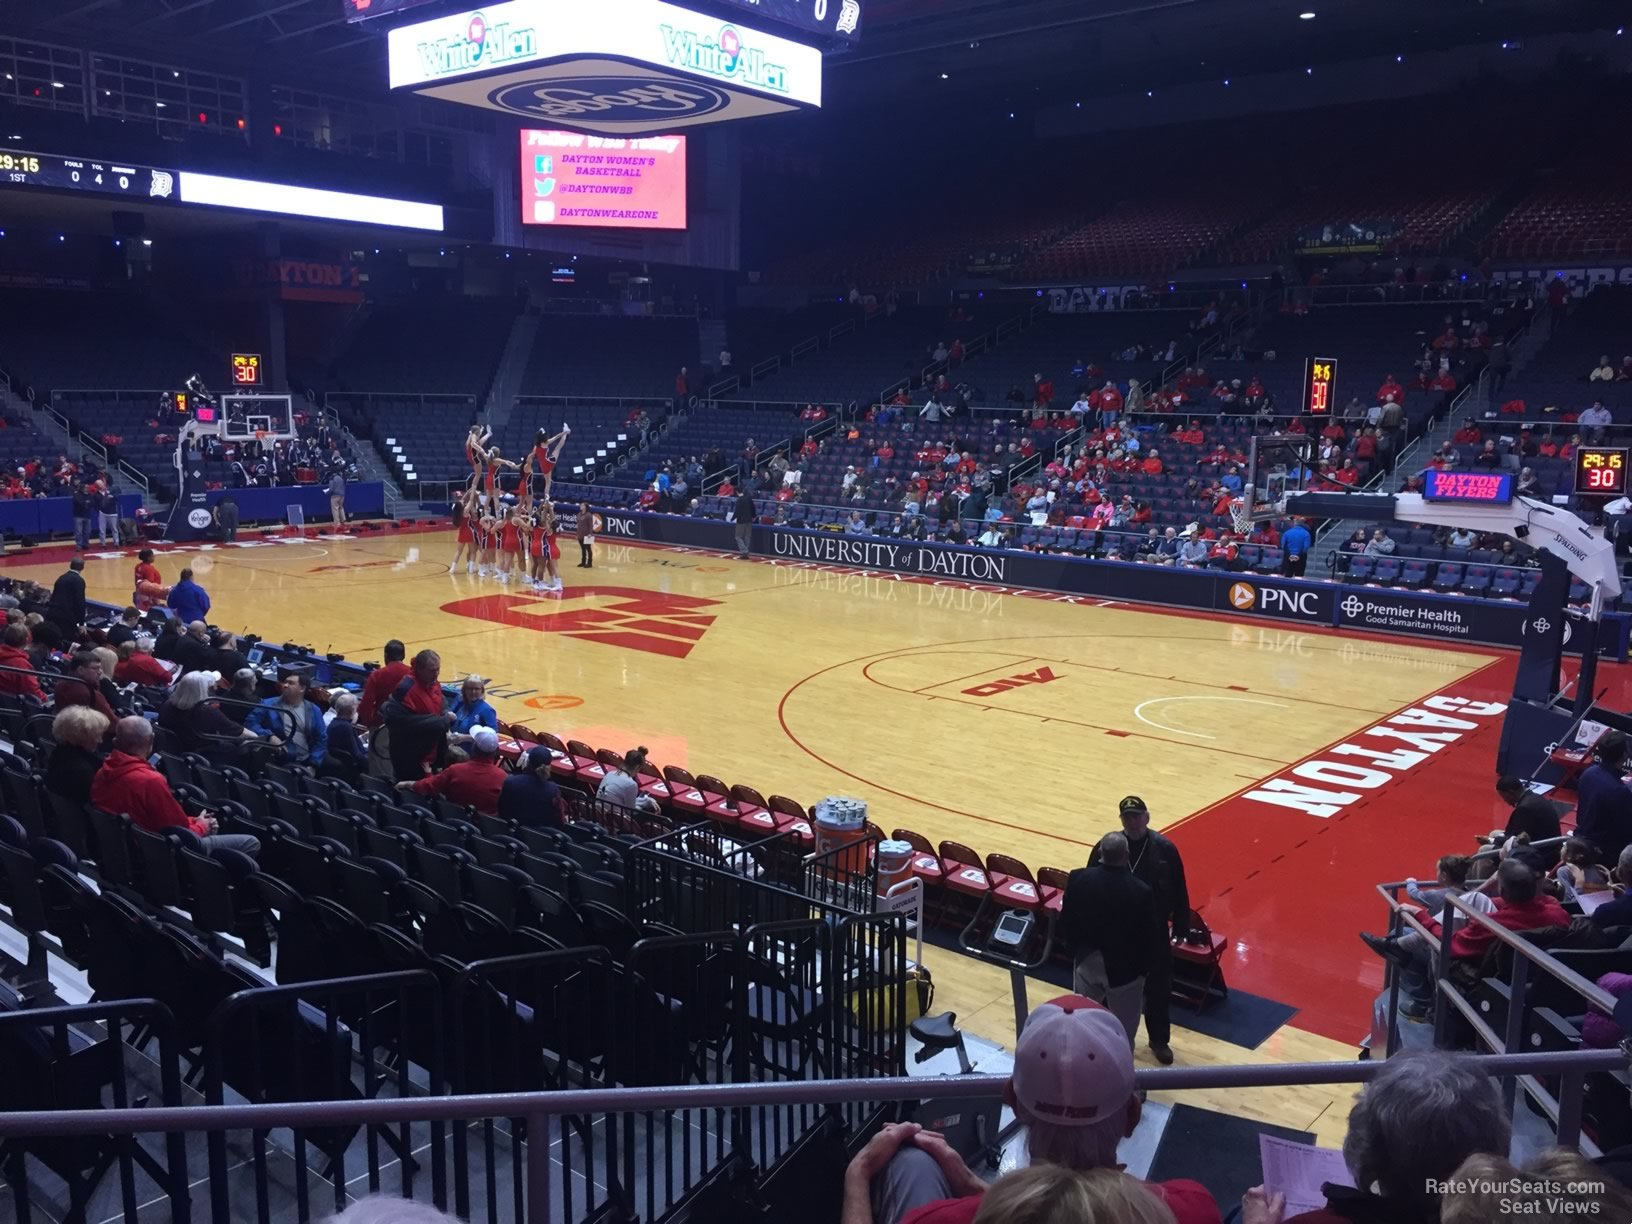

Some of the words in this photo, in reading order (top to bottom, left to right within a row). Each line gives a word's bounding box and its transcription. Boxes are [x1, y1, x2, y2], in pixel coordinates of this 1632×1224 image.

[64, 160, 83, 168] FOULS
[91, 163, 104, 171] TOL
[562, 154, 604, 164] DAYTON
[606, 155, 655, 166] WOMEN'S
[9, 173, 26, 182] 1ST
[575, 166, 642, 177] BASKETBALL
[71, 171, 80, 182] 0
[95, 174, 103, 185] 4
[119, 176, 129, 189] 0
[559, 184, 634, 195] @DAYTONWBB
[559, 207, 659, 219] DAYTONWEAREONE
[237, 366, 256, 382] 30
[1583, 453, 1622, 469] 29:15
[1434, 473, 1503, 488] DAYTON
[1589, 469, 1615, 487] 30
[1435, 485, 1500, 499] FLYERS
[606, 516, 636, 536] PNC
[1553, 533, 1589, 562] SPALDING
[773, 532, 900, 568] UNIVERSITY
[901, 551, 912, 567] of
[918, 548, 1005, 581] DAYTON
[1259, 587, 1319, 615] PNC
[1366, 602, 1415, 618] Premier
[1417, 607, 1461, 623] Health
[1365, 614, 1387, 625] Good
[1389, 617, 1431, 630] Samaritan
[1433, 622, 1469, 634] Hospital
[1241, 694, 1509, 819] DAYTON
